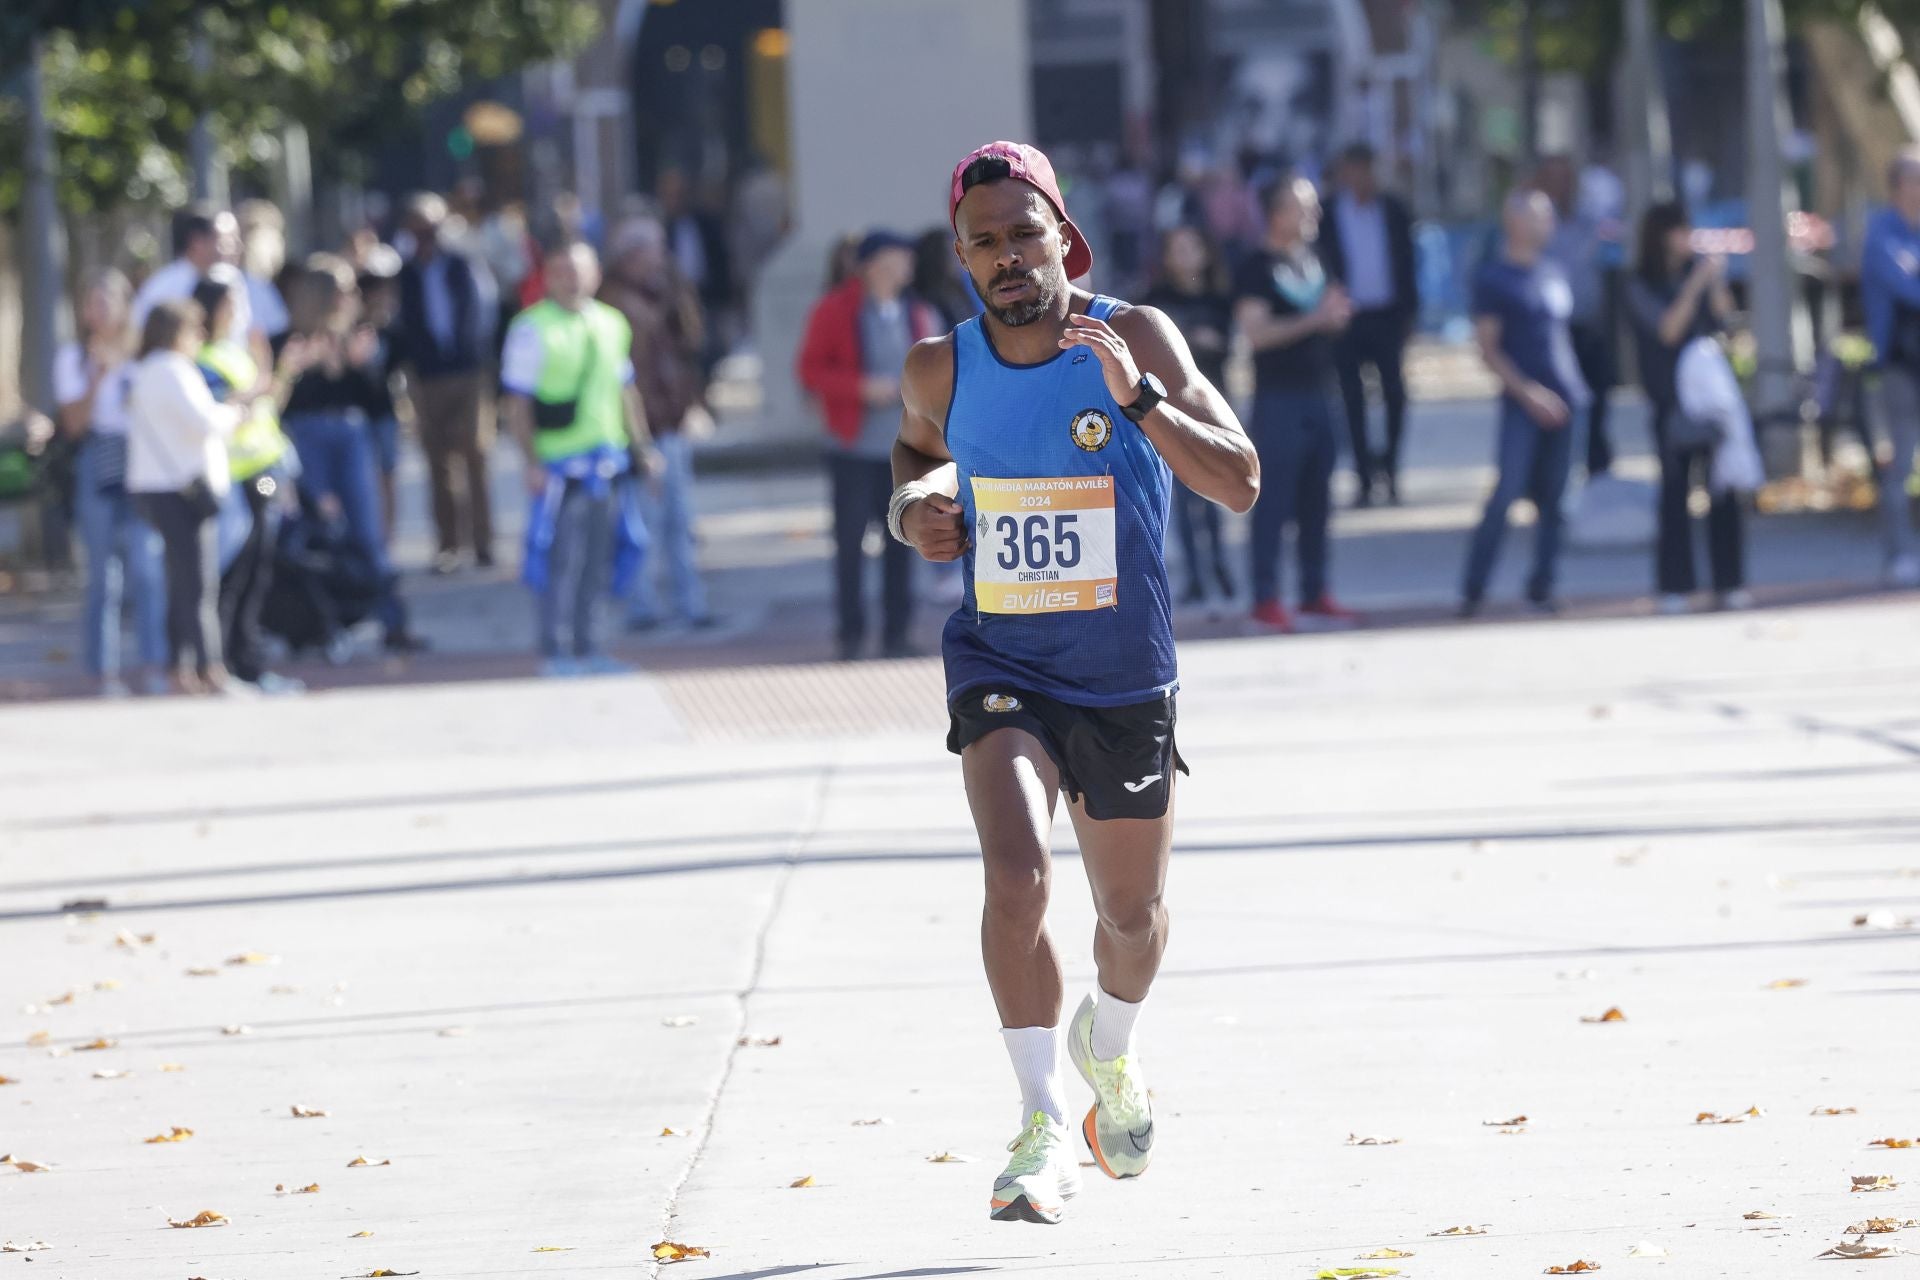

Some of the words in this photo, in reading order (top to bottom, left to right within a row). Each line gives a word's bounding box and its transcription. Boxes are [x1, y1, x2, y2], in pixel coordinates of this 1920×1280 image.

[994, 482, 1022, 492] MEDIA
[1024, 479, 1073, 491] MARATÓN
[1075, 477, 1109, 489] AVILÉS
[1019, 496, 1051, 507] 2024
[996, 514, 1081, 570] 365
[1018, 571, 1060, 581] CHRISTIAN
[1002, 588, 1079, 609] avilés
